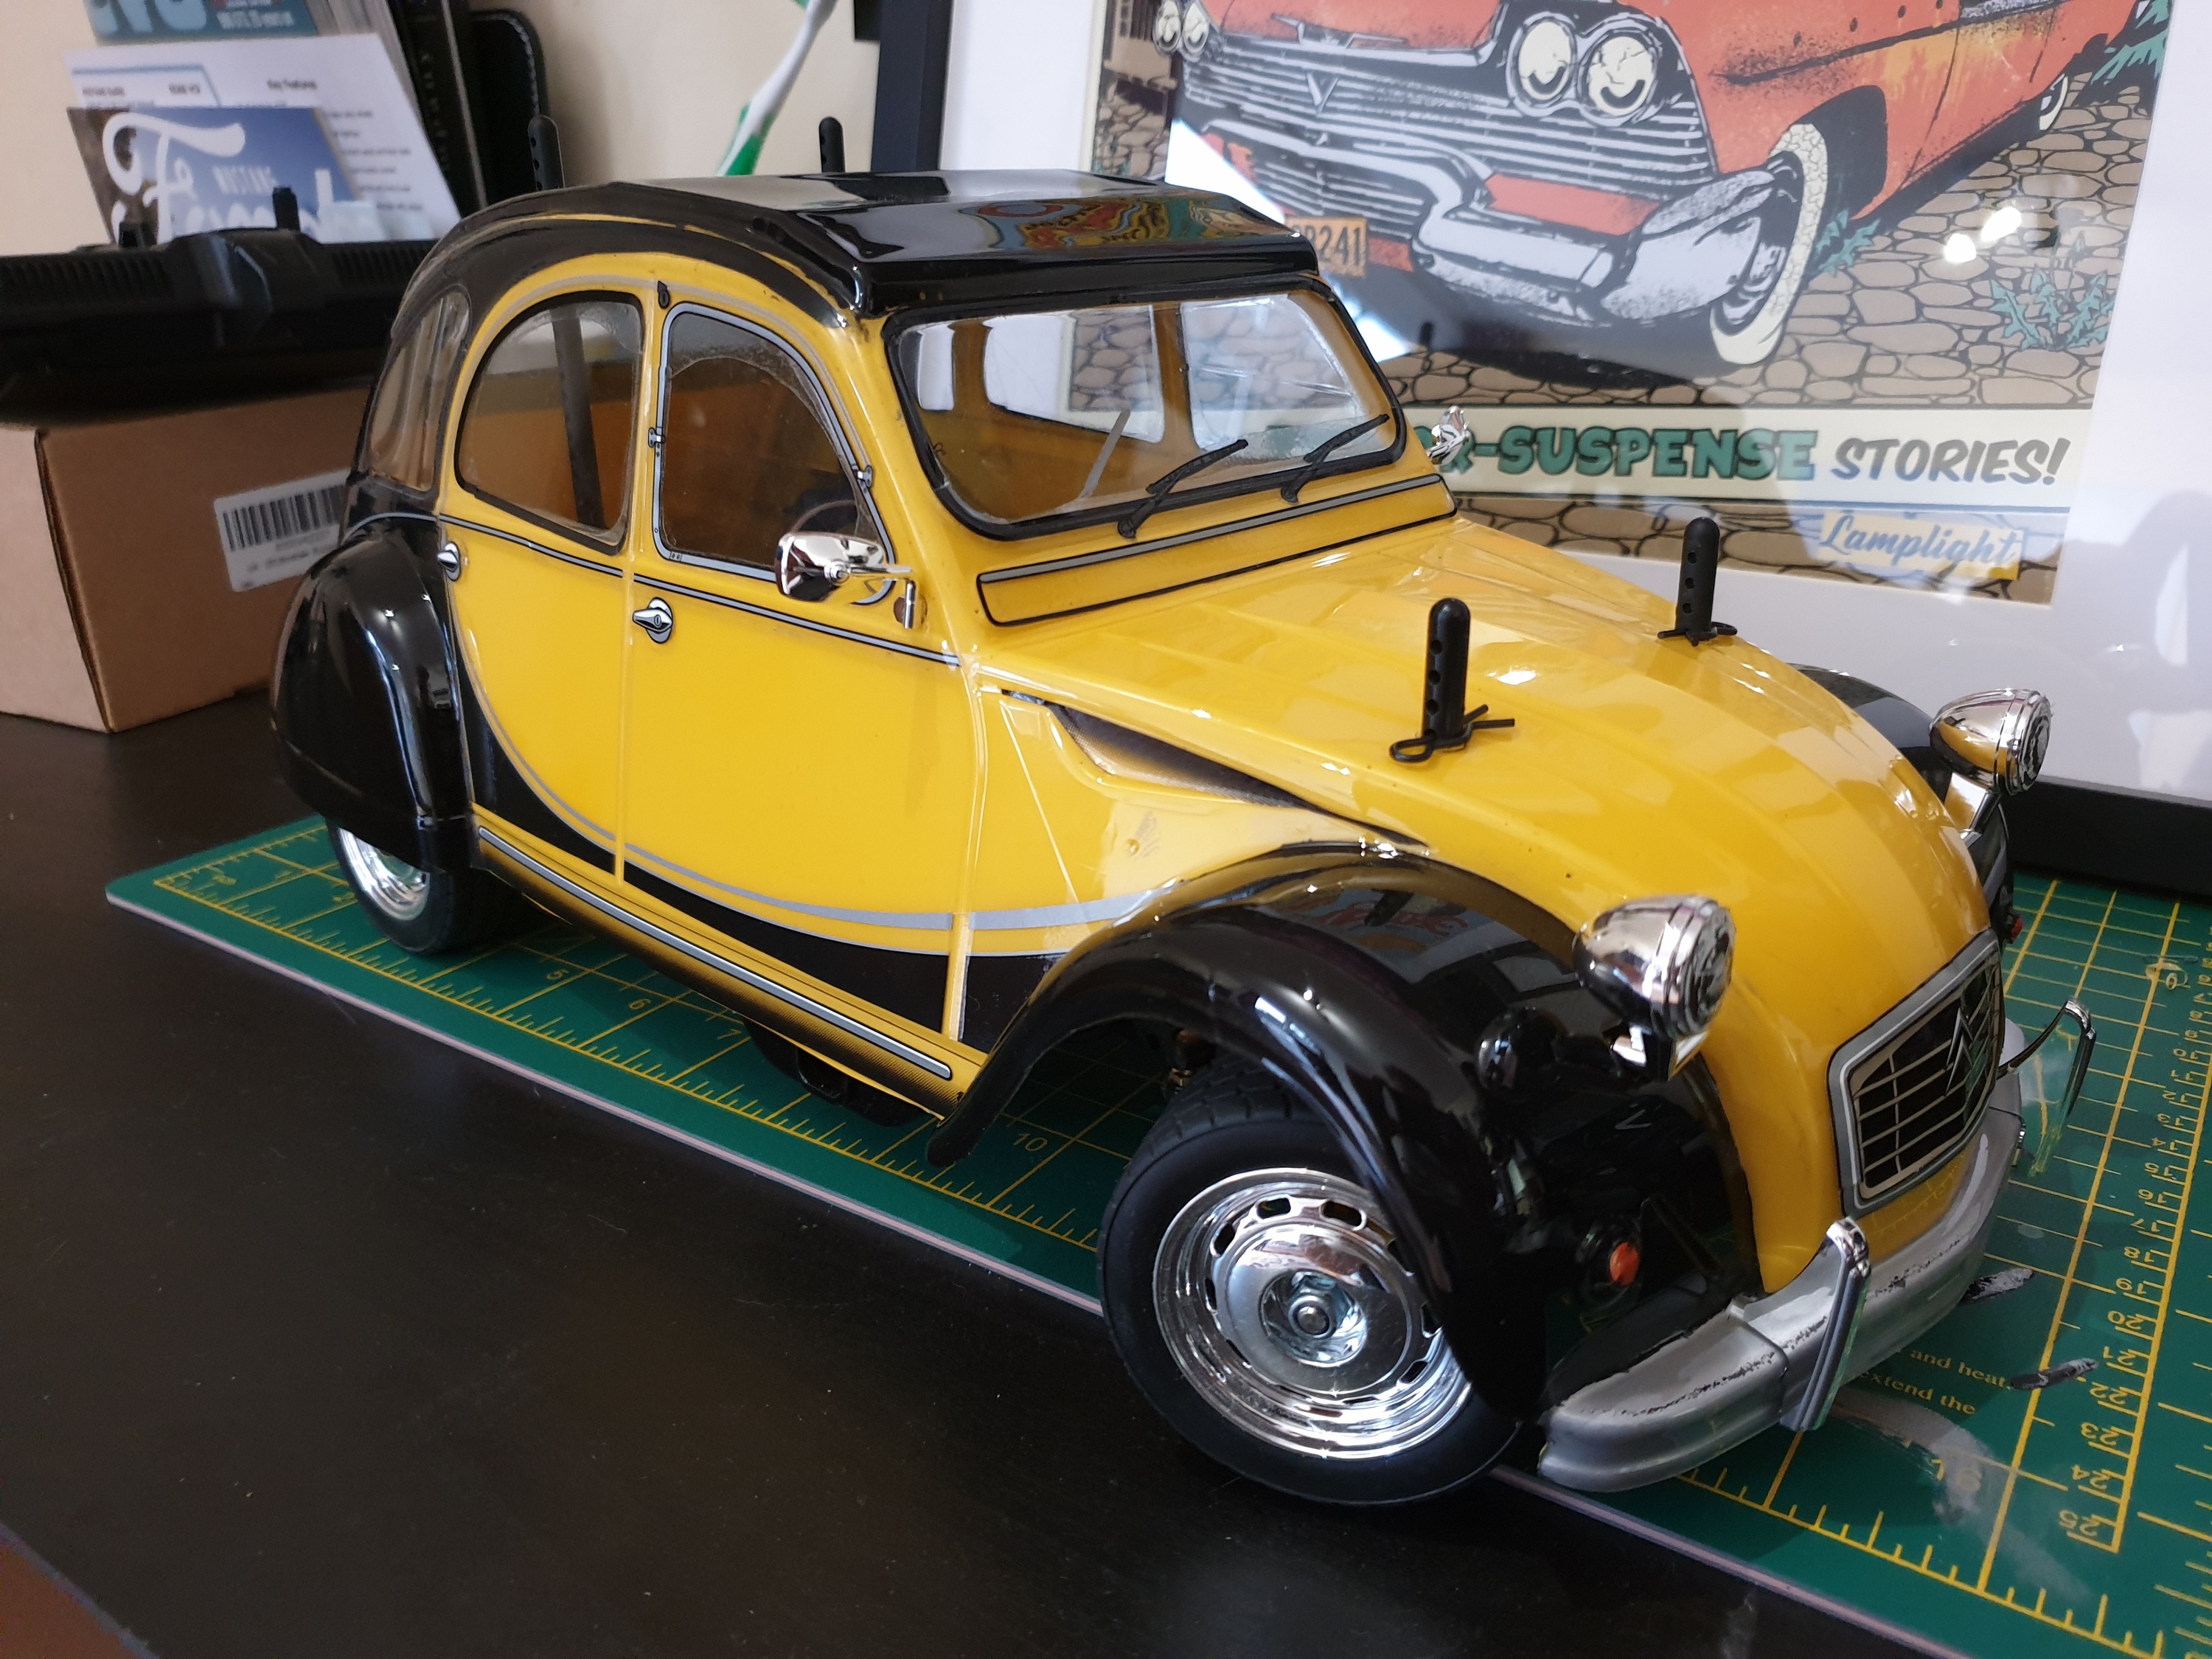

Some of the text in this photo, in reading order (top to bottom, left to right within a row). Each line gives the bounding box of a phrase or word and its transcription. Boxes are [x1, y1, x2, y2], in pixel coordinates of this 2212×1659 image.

[1292, 224, 1360, 265] 241
[1830, 437, 2071, 486] STORIES!
[1819, 515, 2022, 578] Lamplight
[1012, 1133, 1048, 1152] 10
[2144, 1162, 2173, 1177] 15
[2138, 1189, 2167, 1203] 16
[2130, 1218, 2160, 1233] 17
[2124, 1246, 2154, 1262] 18
[2115, 1277, 2147, 1294] 19
[2107, 1310, 2144, 1330] 20
[1910, 1350, 1952, 1369] and
[2103, 1346, 2137, 1366] 21
[2090, 1381, 2129, 1405] 22
[1940, 1394, 1976, 1415] the
[2081, 1422, 2119, 1446] 23
[2071, 1464, 2112, 1490] 24
[2059, 1509, 2101, 1537] 25
